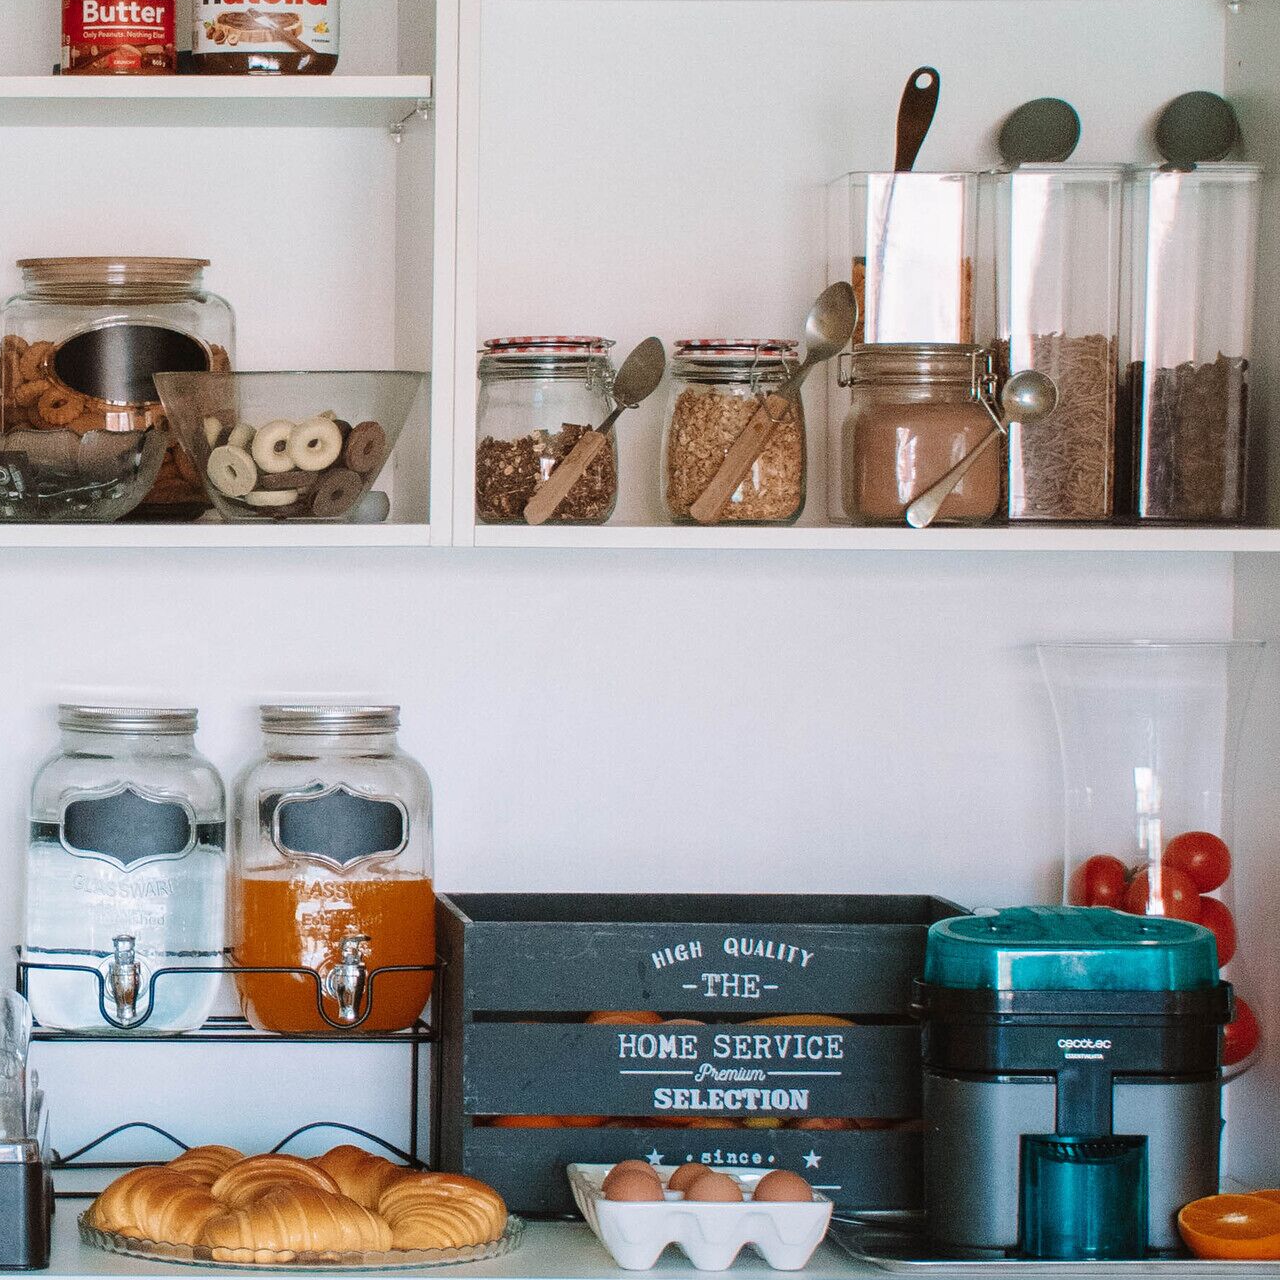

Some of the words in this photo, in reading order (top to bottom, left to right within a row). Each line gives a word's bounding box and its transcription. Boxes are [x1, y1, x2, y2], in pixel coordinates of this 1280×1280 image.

[82, 0, 166, 24] Butter
[82, 31, 98, 40] Only
[127, 31, 153, 40] Nothing
[651, 940, 703, 969] HIGH
[723, 937, 815, 968] QUALITY
[701, 972, 761, 999] THE
[618, 1033, 698, 1059] HOME
[713, 1034, 844, 1060] SERVICE
[1057, 1038, 1112, 1049] cecotec
[694, 1062, 767, 1083] Premium
[653, 1087, 810, 1111] SELECTION
[700, 1148, 763, 1165] since
